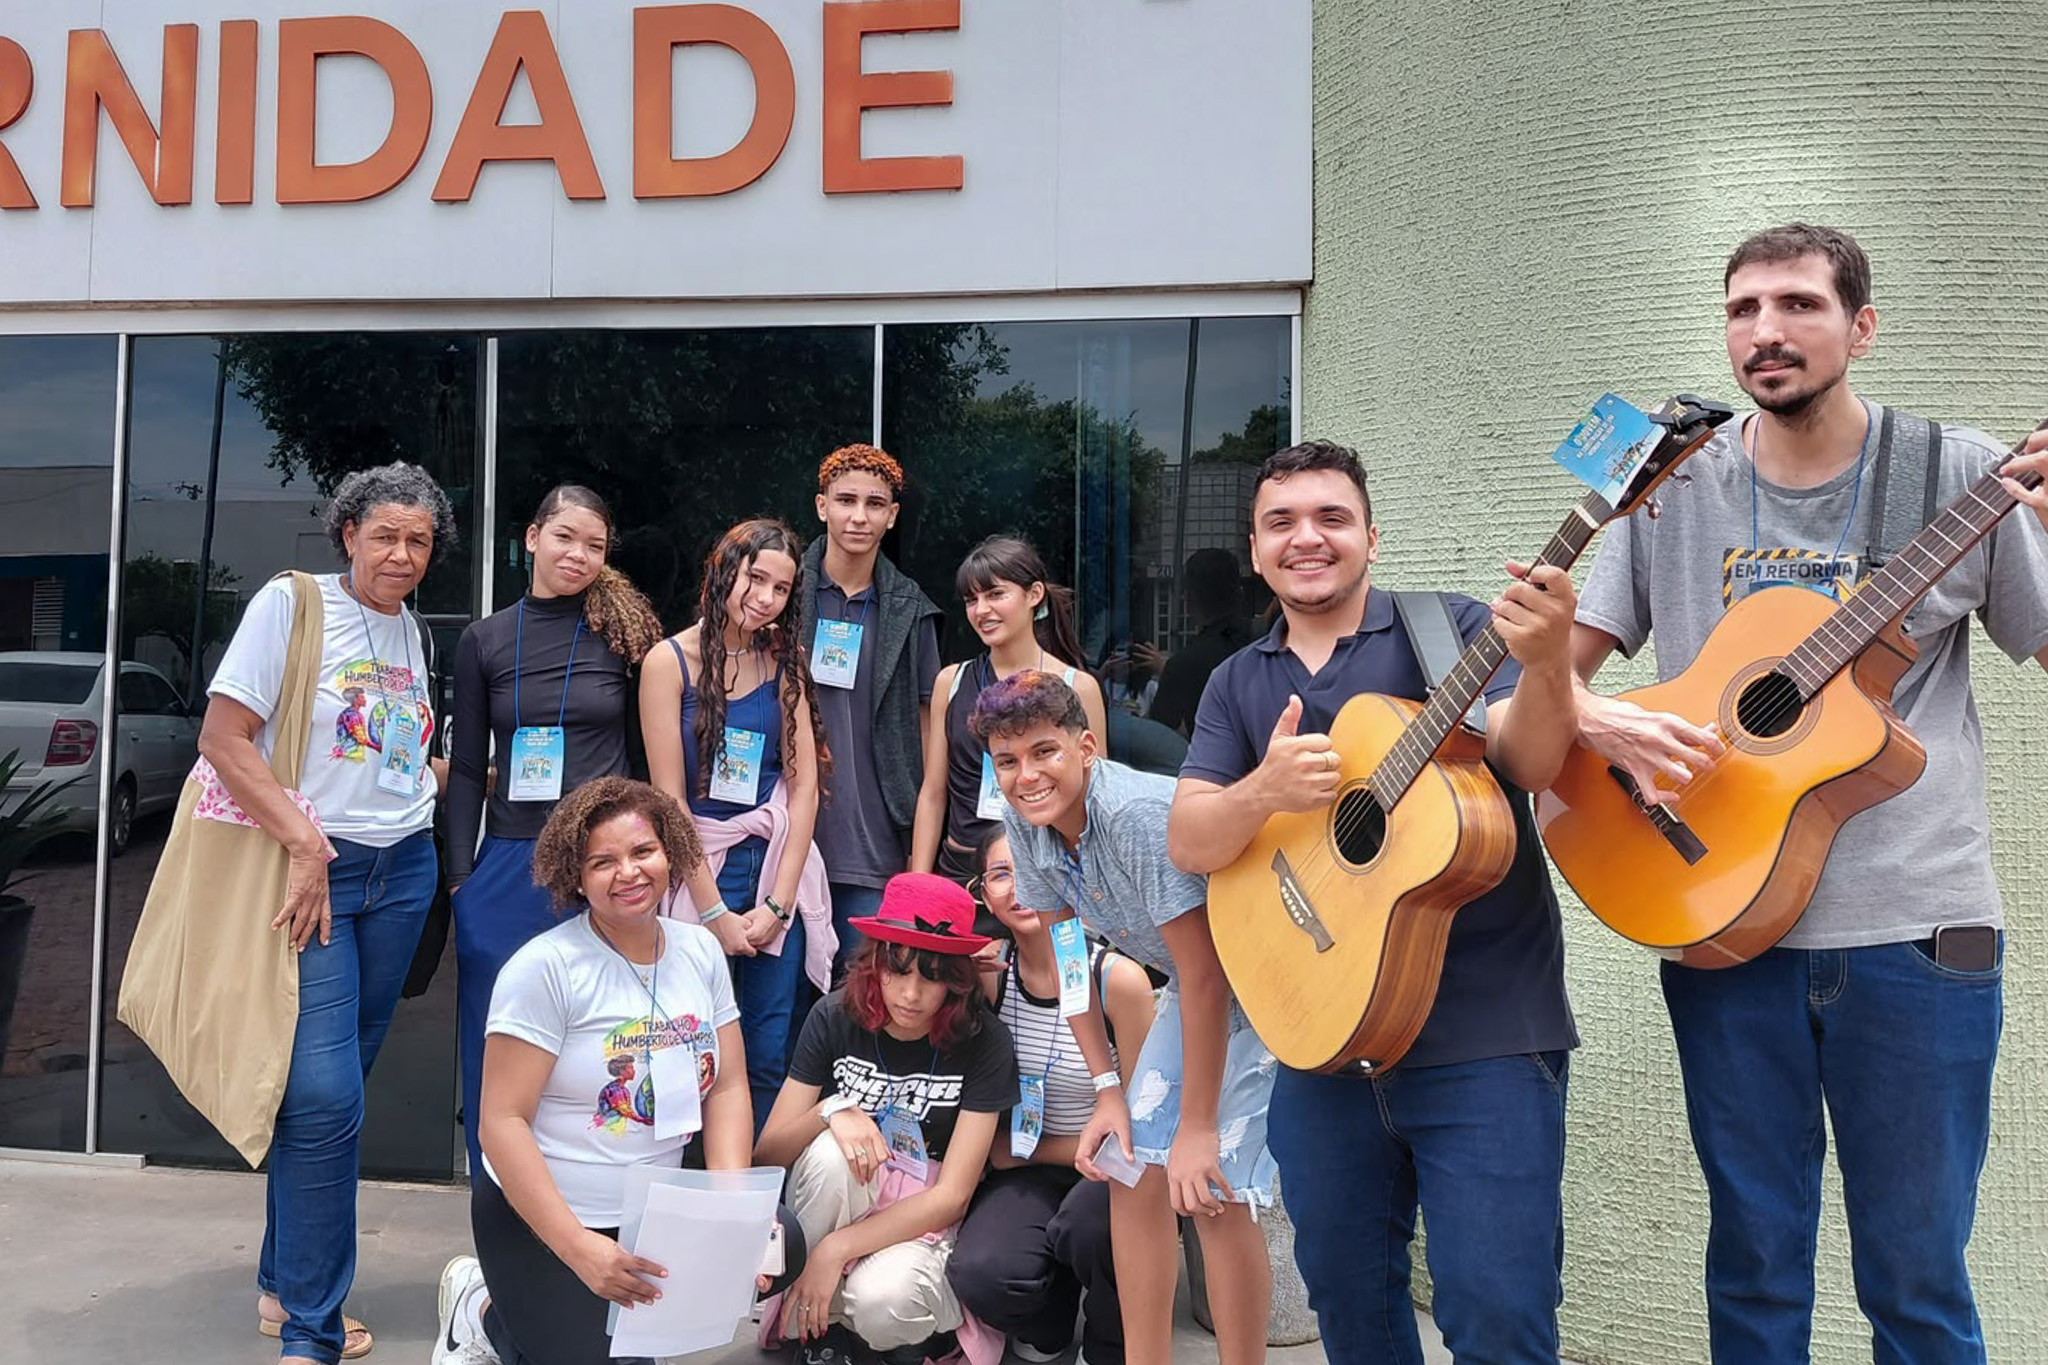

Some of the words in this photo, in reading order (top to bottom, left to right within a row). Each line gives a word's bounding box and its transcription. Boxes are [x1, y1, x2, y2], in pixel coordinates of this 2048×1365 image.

[1735, 562, 1761, 579] EM
[1765, 561, 1853, 579] REFORMA
[847, 1061, 870, 1075] THE
[833, 1064, 963, 1100] POWERPUFF
